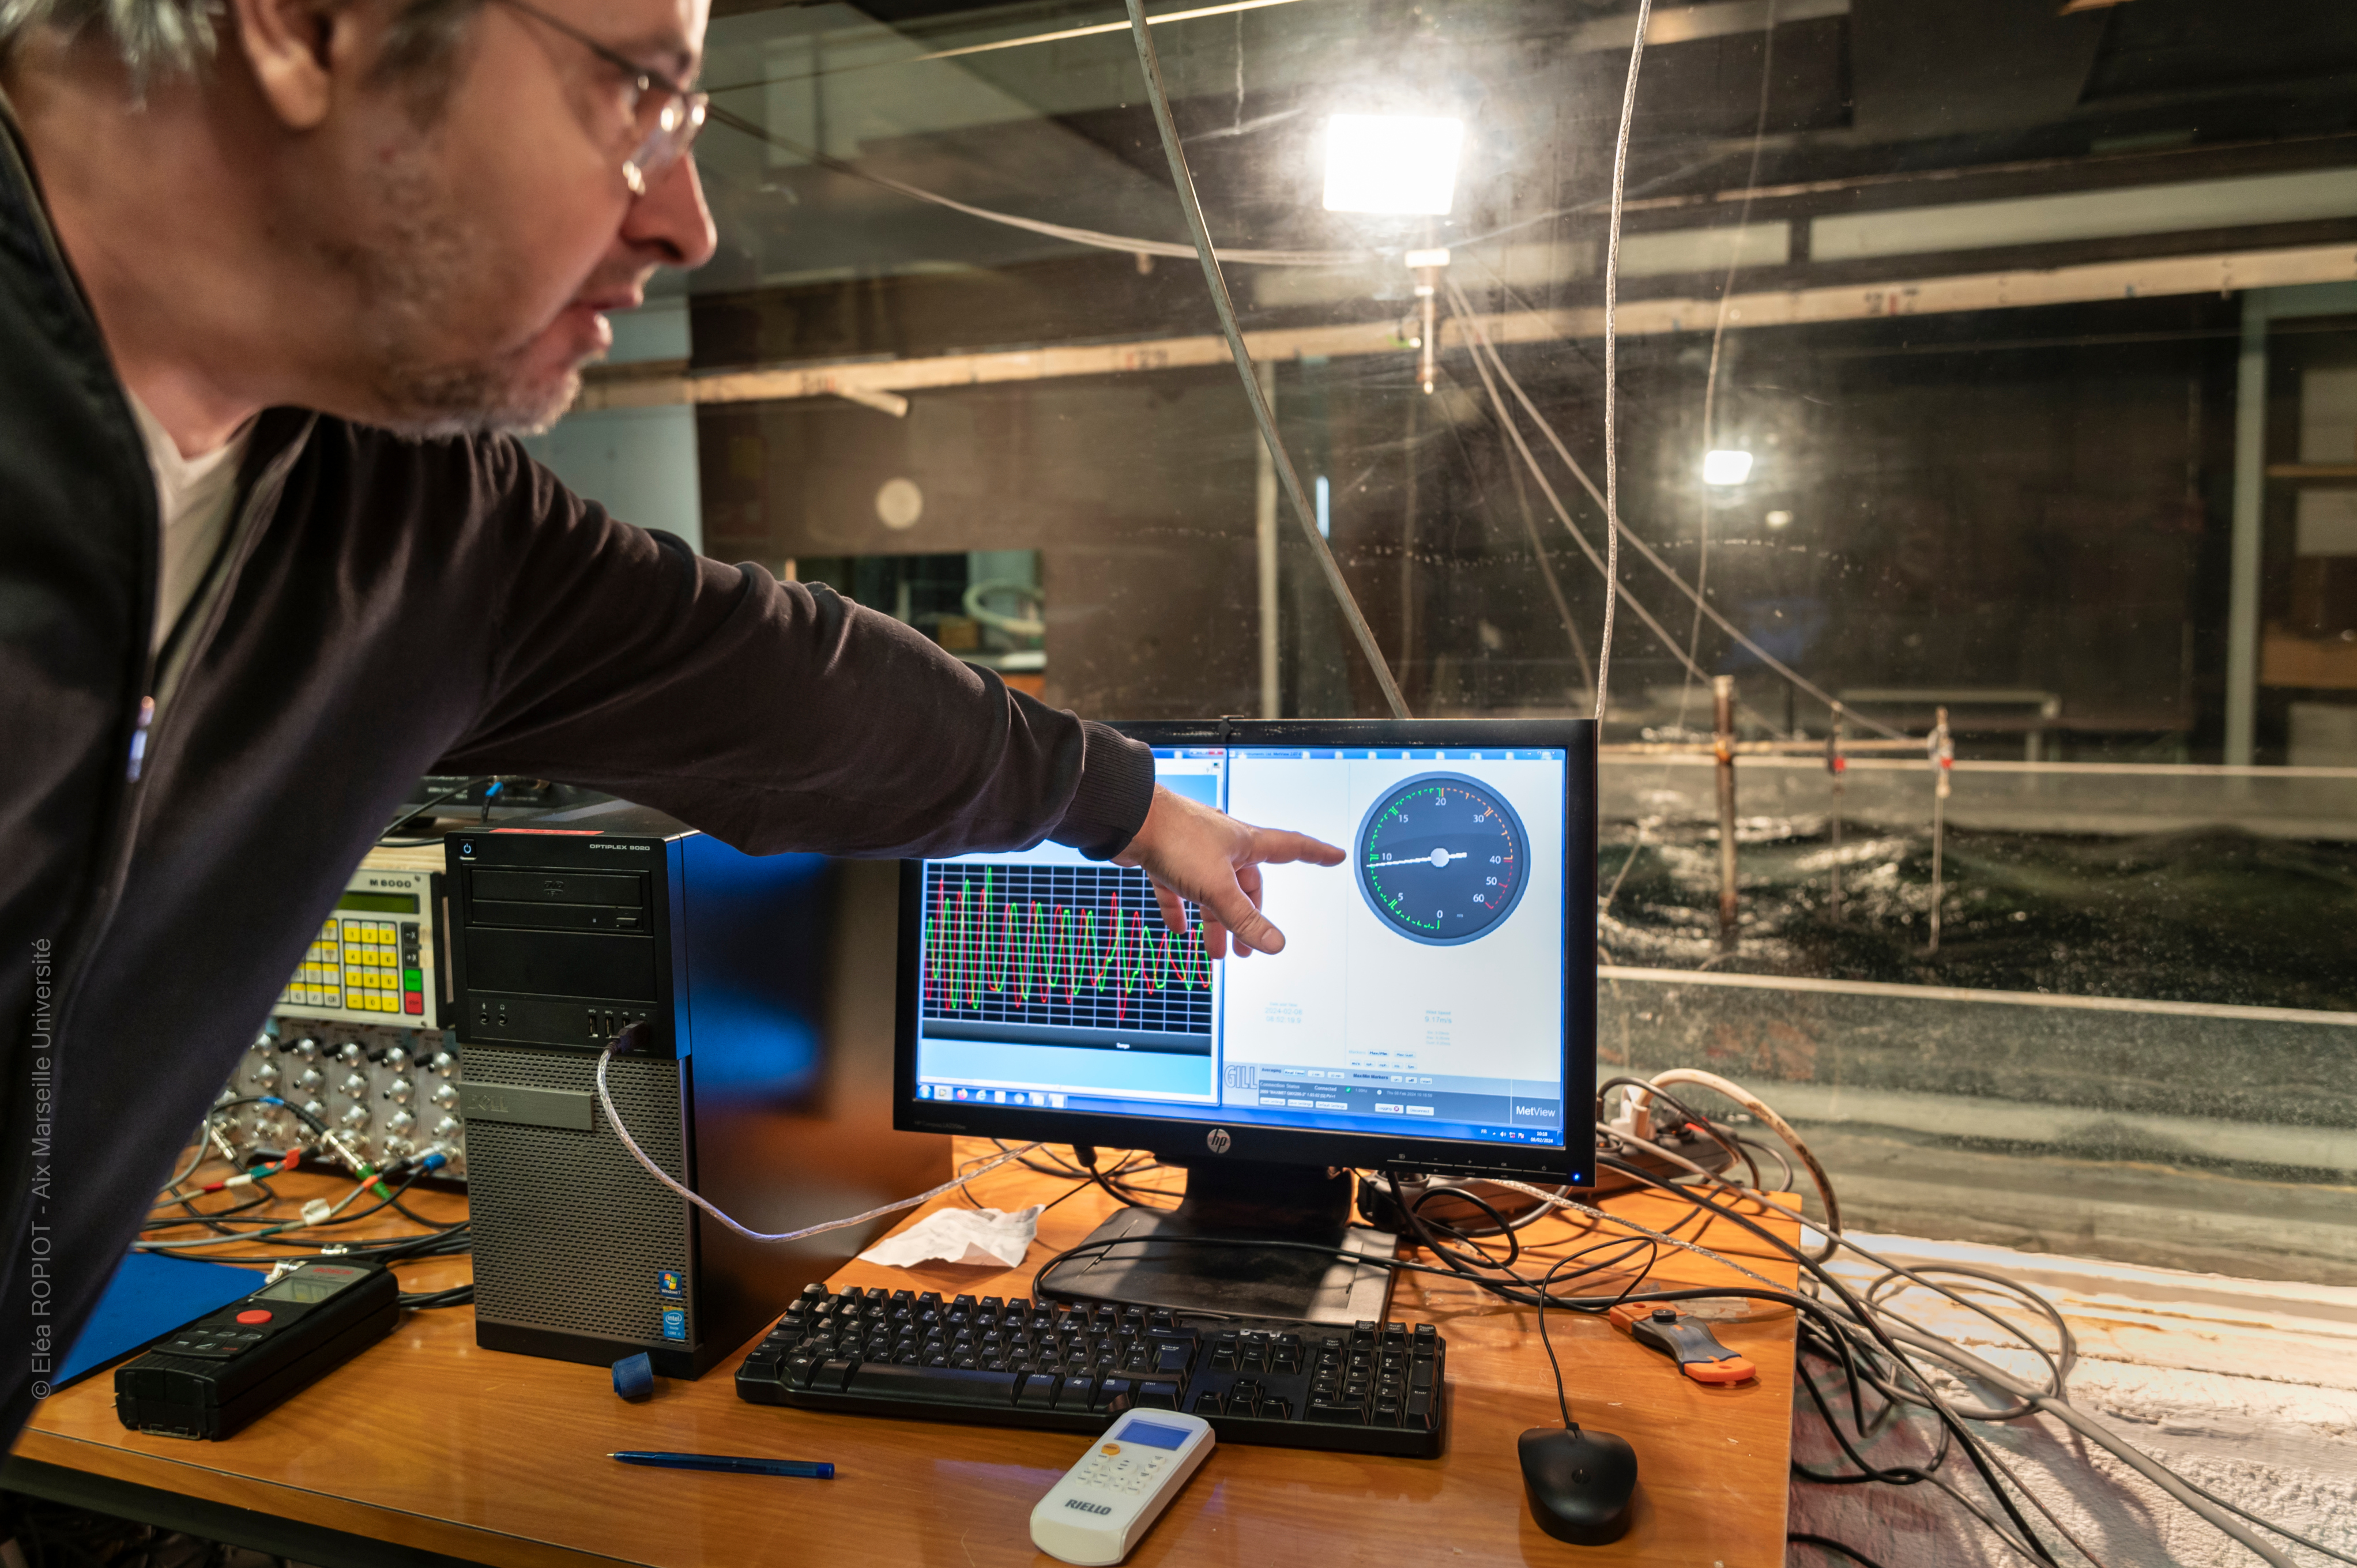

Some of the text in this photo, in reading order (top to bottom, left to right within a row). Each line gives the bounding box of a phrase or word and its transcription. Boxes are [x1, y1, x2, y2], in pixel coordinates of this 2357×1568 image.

[1436, 797, 1446, 805] 20
[1399, 815, 1409, 823] 15
[1473, 815, 1484, 823] 30
[1489, 855, 1501, 864] 40
[1486, 876, 1497, 885] 50
[1398, 892, 1403, 901] 5
[1473, 894, 1484, 902] 60
[1437, 910, 1443, 918] 0
[1224, 1065, 1257, 1090] GILL
[466, 1094, 509, 1113] DELL
[1516, 1106, 1556, 1117] MetView
[1210, 1128, 1229, 1153] hp
[312, 1267, 354, 1275] BOSCH
[1064, 1498, 1112, 1516] RIELLO
